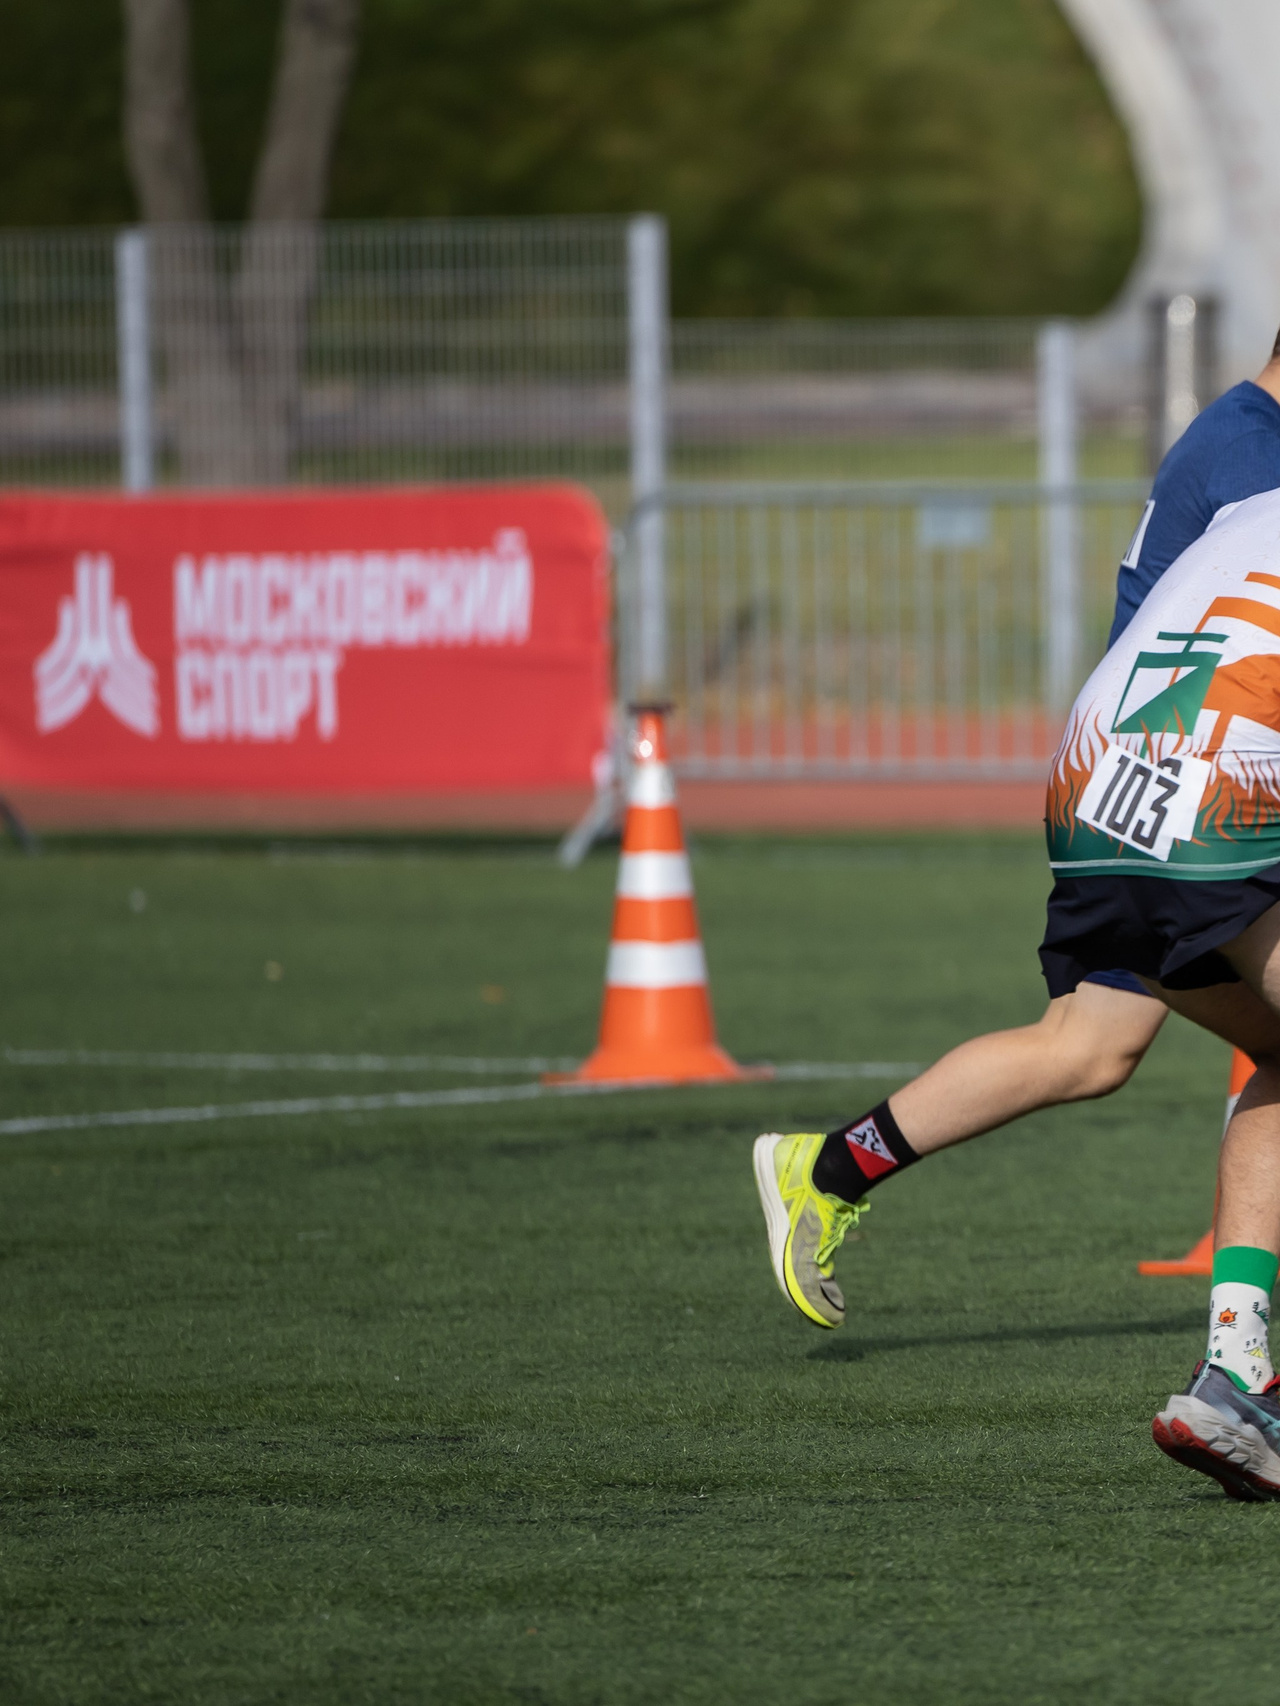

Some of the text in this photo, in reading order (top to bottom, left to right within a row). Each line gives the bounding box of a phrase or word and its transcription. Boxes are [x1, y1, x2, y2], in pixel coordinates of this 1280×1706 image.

[173, 527, 532, 646] МОСКОВСКИЙ
[175, 646, 342, 742] СПОРТ
[1092, 754, 1181, 850] 103
